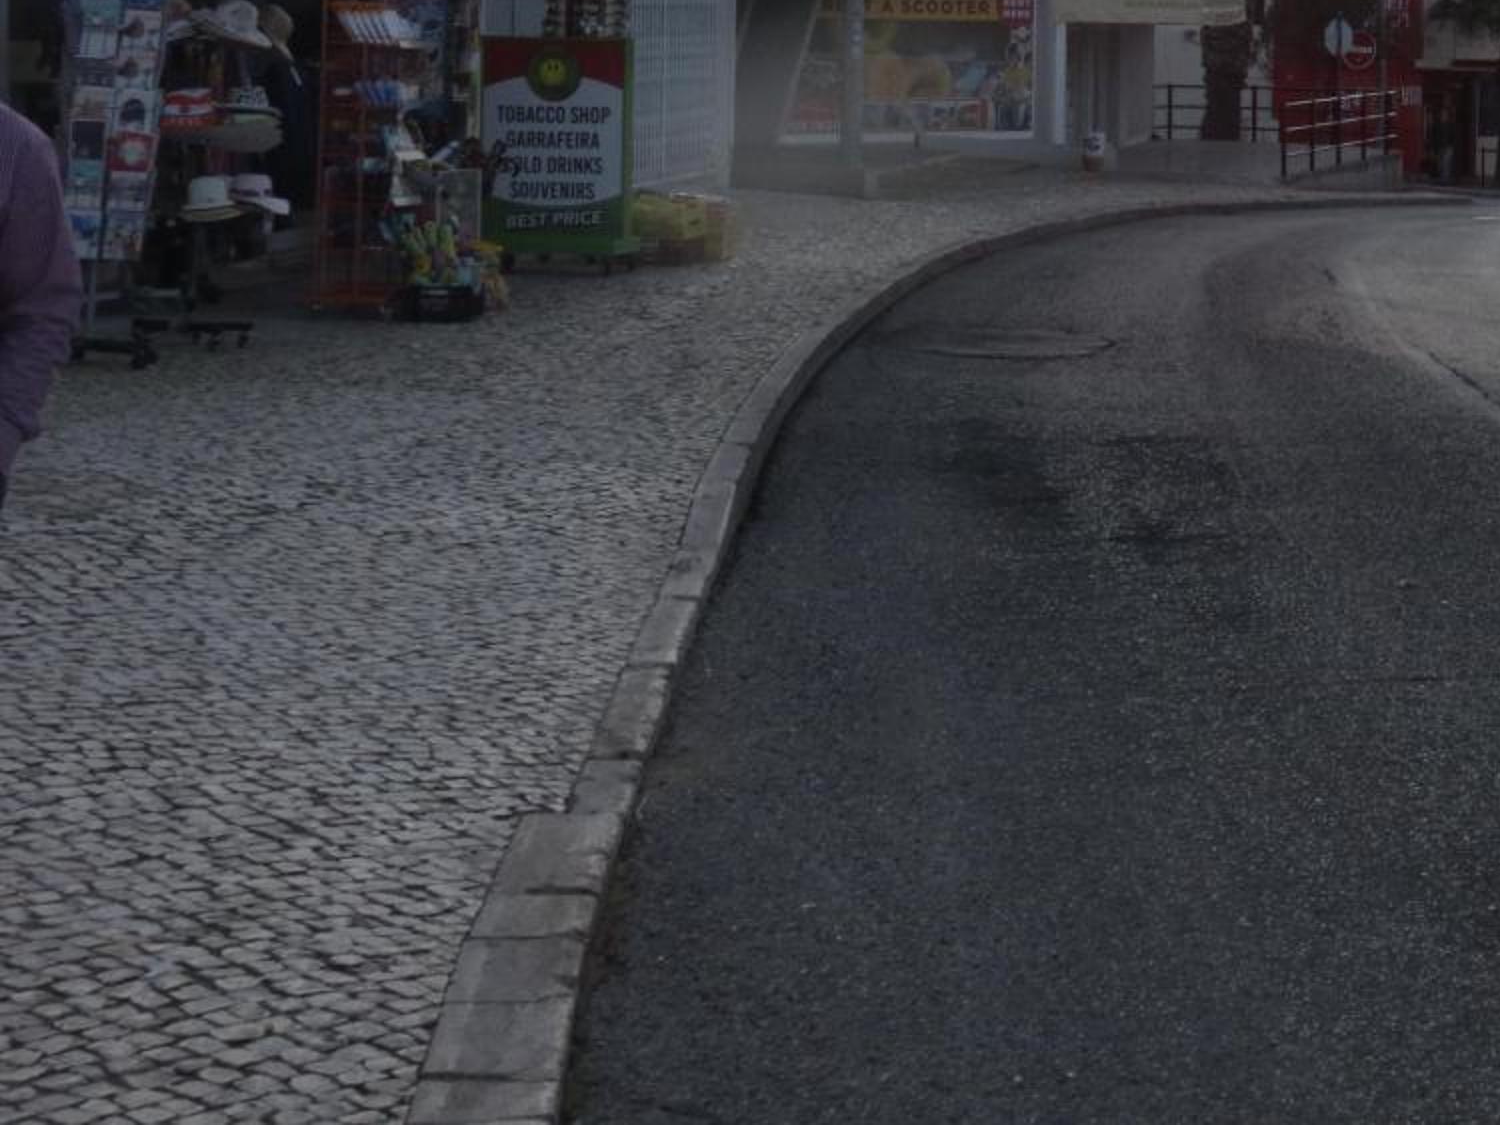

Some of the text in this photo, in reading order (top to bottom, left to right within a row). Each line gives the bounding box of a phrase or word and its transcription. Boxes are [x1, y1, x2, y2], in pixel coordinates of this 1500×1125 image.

[497, 105, 611, 125] TOBACCO SHOP
[505, 131, 600, 150] GARRAFEIRA
[547, 156, 603, 174] DRINKS
[510, 181, 595, 200] SOUVENIRS
